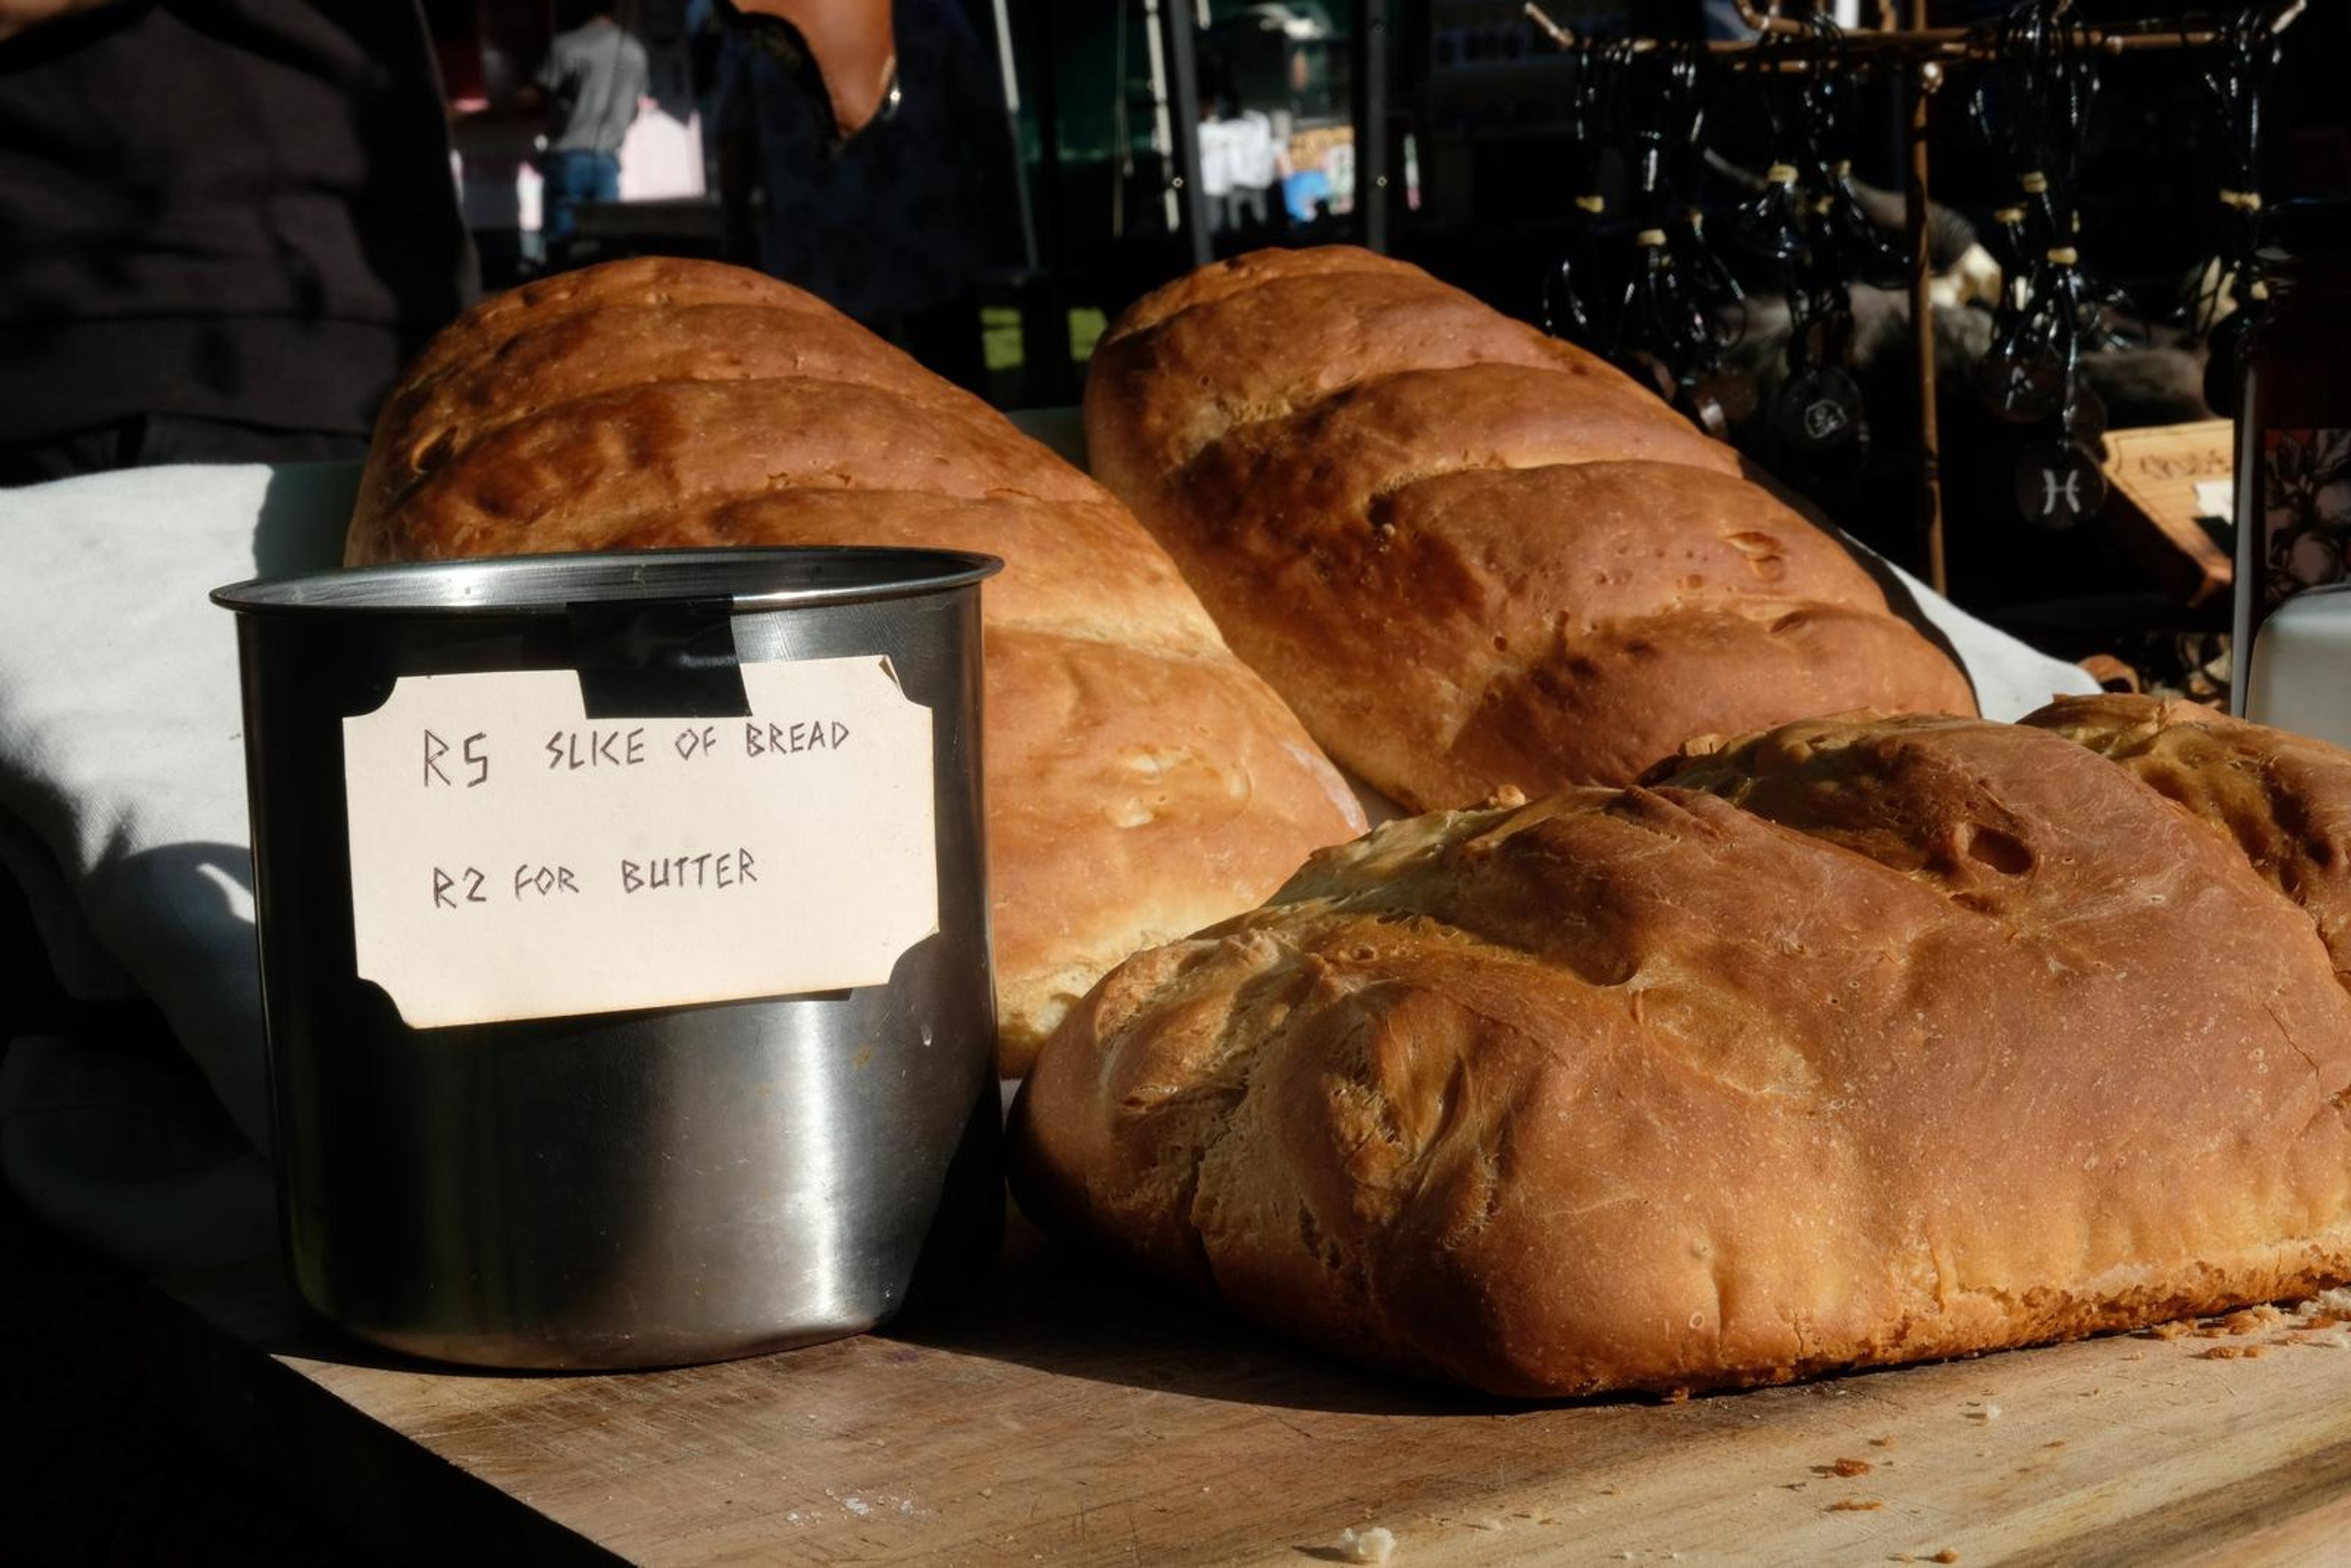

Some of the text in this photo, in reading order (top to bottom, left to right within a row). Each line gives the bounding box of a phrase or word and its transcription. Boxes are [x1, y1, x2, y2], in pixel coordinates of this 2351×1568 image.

[424, 721, 850, 788] R5 SLICE OF BREAD
[433, 848, 757, 909] R2 FOR BUTTER
